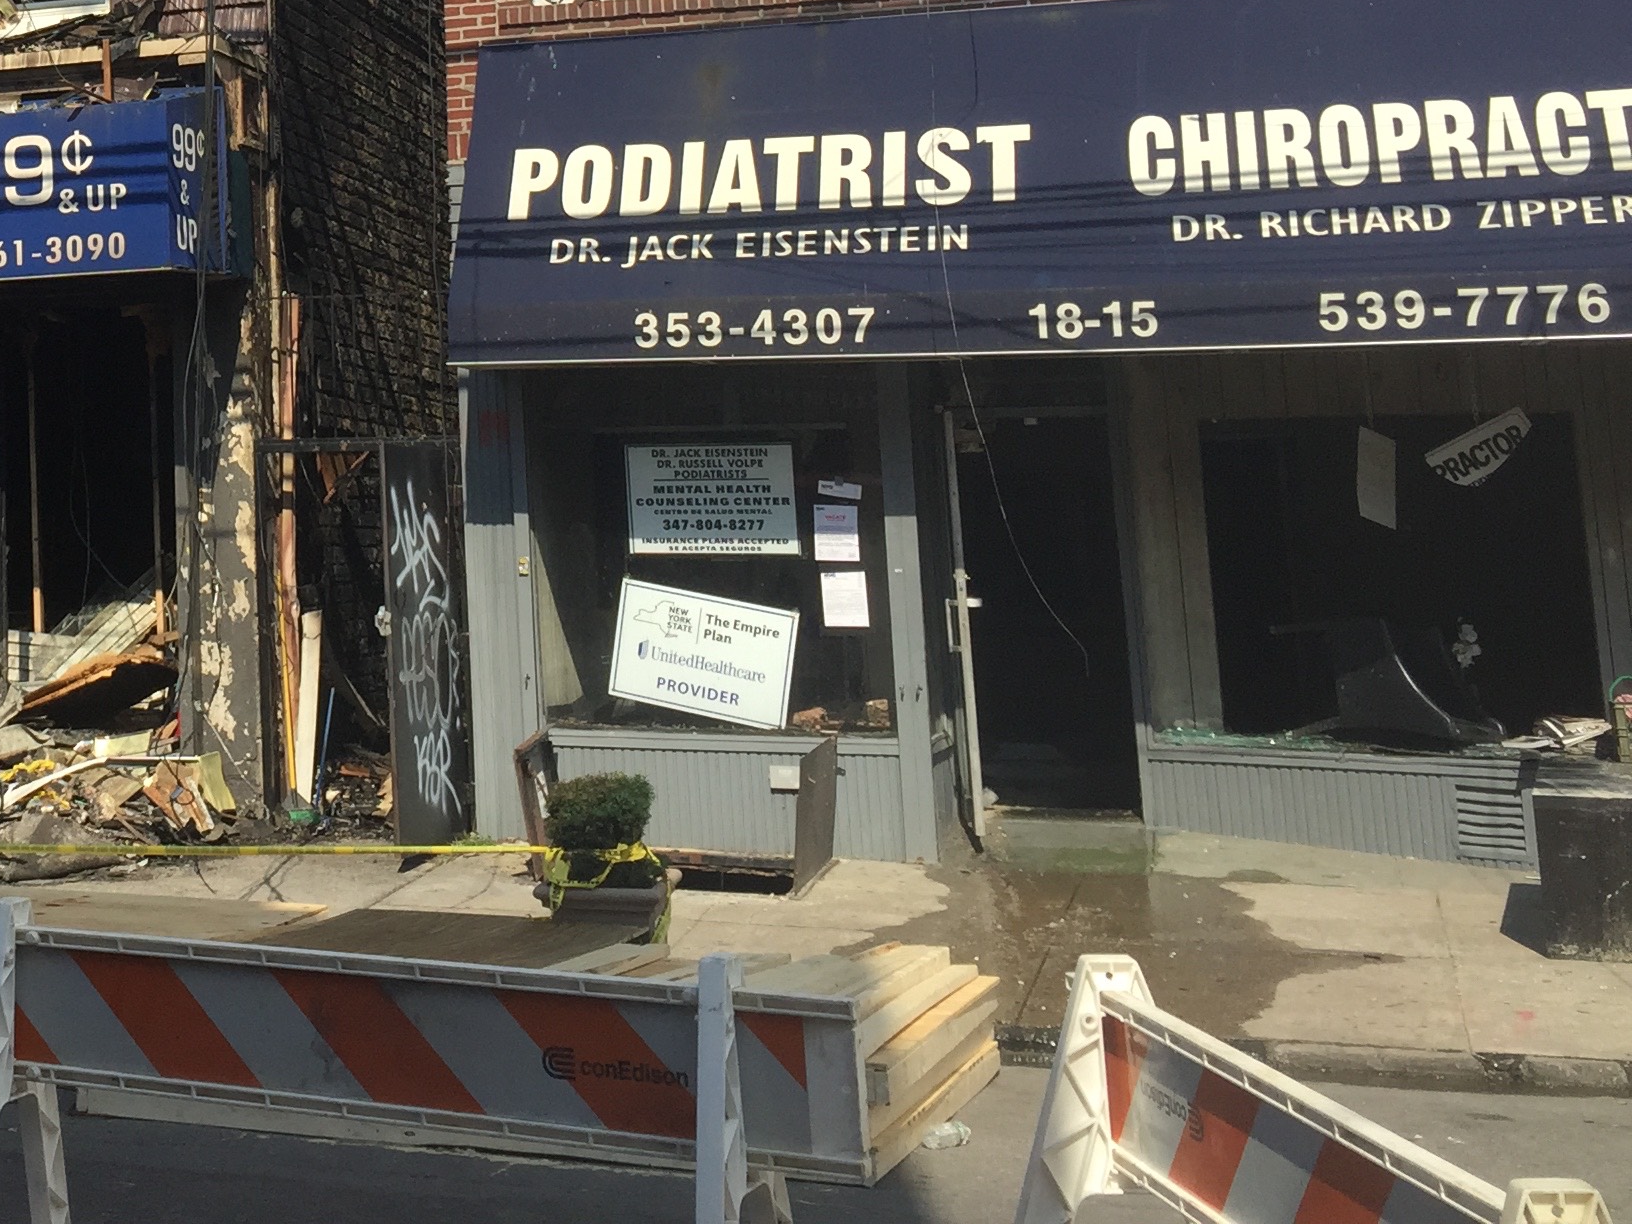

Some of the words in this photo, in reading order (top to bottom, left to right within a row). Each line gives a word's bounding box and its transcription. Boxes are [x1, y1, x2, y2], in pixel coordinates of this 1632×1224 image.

[1127, 88, 1632, 196] CHIROPRACT
[506, 123, 1031, 221] PODIATRIST
[57, 188, 80, 214] &
[85, 182, 128, 212] UP
[180, 179, 189, 205] &
[1171, 213, 1244, 243] DR.
[1259, 202, 1452, 240] RICHARD
[1477, 194, 1632, 231] ZIPPER
[176, 213, 198, 255] UP
[549, 237, 611, 265] DR.
[620, 232, 714, 268] JACK
[734, 223, 970, 259] EISENSTEIN
[1028, 300, 1159, 340] 18-15
[1318, 282, 1611, 332] 539-7776
[633, 306, 876, 349] 353-4307
[651, 448, 670, 458] DR.
[673, 448, 702, 458] JACK
[705, 447, 768, 458] EISENSTEIN
[657, 459, 676, 469] DR.
[678, 459, 724, 469] RUSSELL
[727, 458, 764, 468] VOLPE
[674, 469, 748, 479] PODIATRISTS
[635, 497, 730, 507] COUNSELING
[733, 496, 791, 506] CENTER
[653, 485, 712, 494] MENTAL
[715, 484, 772, 494] HEALTH
[662, 518, 765, 531] 347-804-8277
[668, 613, 692, 626] YORK
[669, 605, 689, 617] NEW
[666, 621, 693, 634] STATE
[702, 628, 732, 645] Plan
[705, 613, 731, 629] The
[732, 618, 781, 639] Empire
[650, 645, 767, 684] UnitedHealthcare
[656, 676, 741, 707] PROVIDER
[580, 1059, 690, 1088] conEdison
